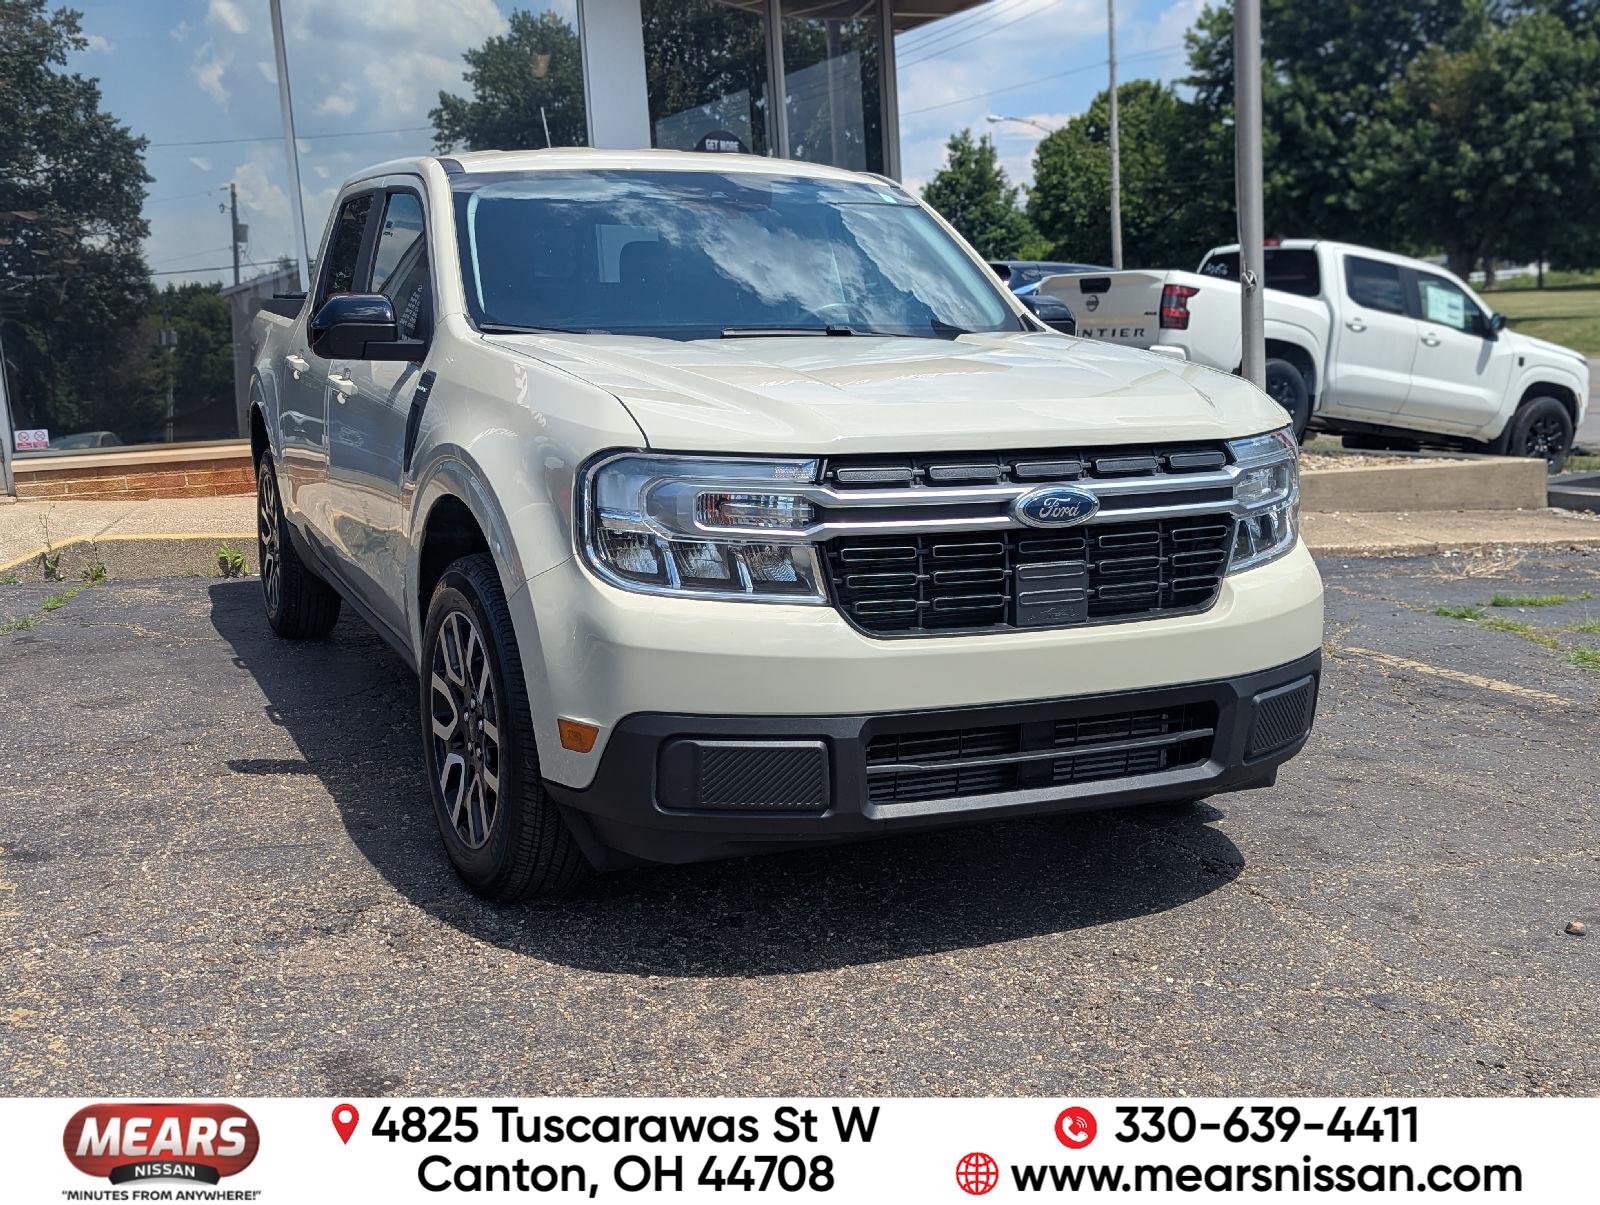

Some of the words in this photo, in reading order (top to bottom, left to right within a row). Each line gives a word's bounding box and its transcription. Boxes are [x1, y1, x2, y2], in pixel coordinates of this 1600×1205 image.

[705, 139, 719, 151] GET
[719, 140, 739, 152] MORE
[1077, 327, 1145, 338] NTIER
[1038, 497, 1081, 519] Ford
